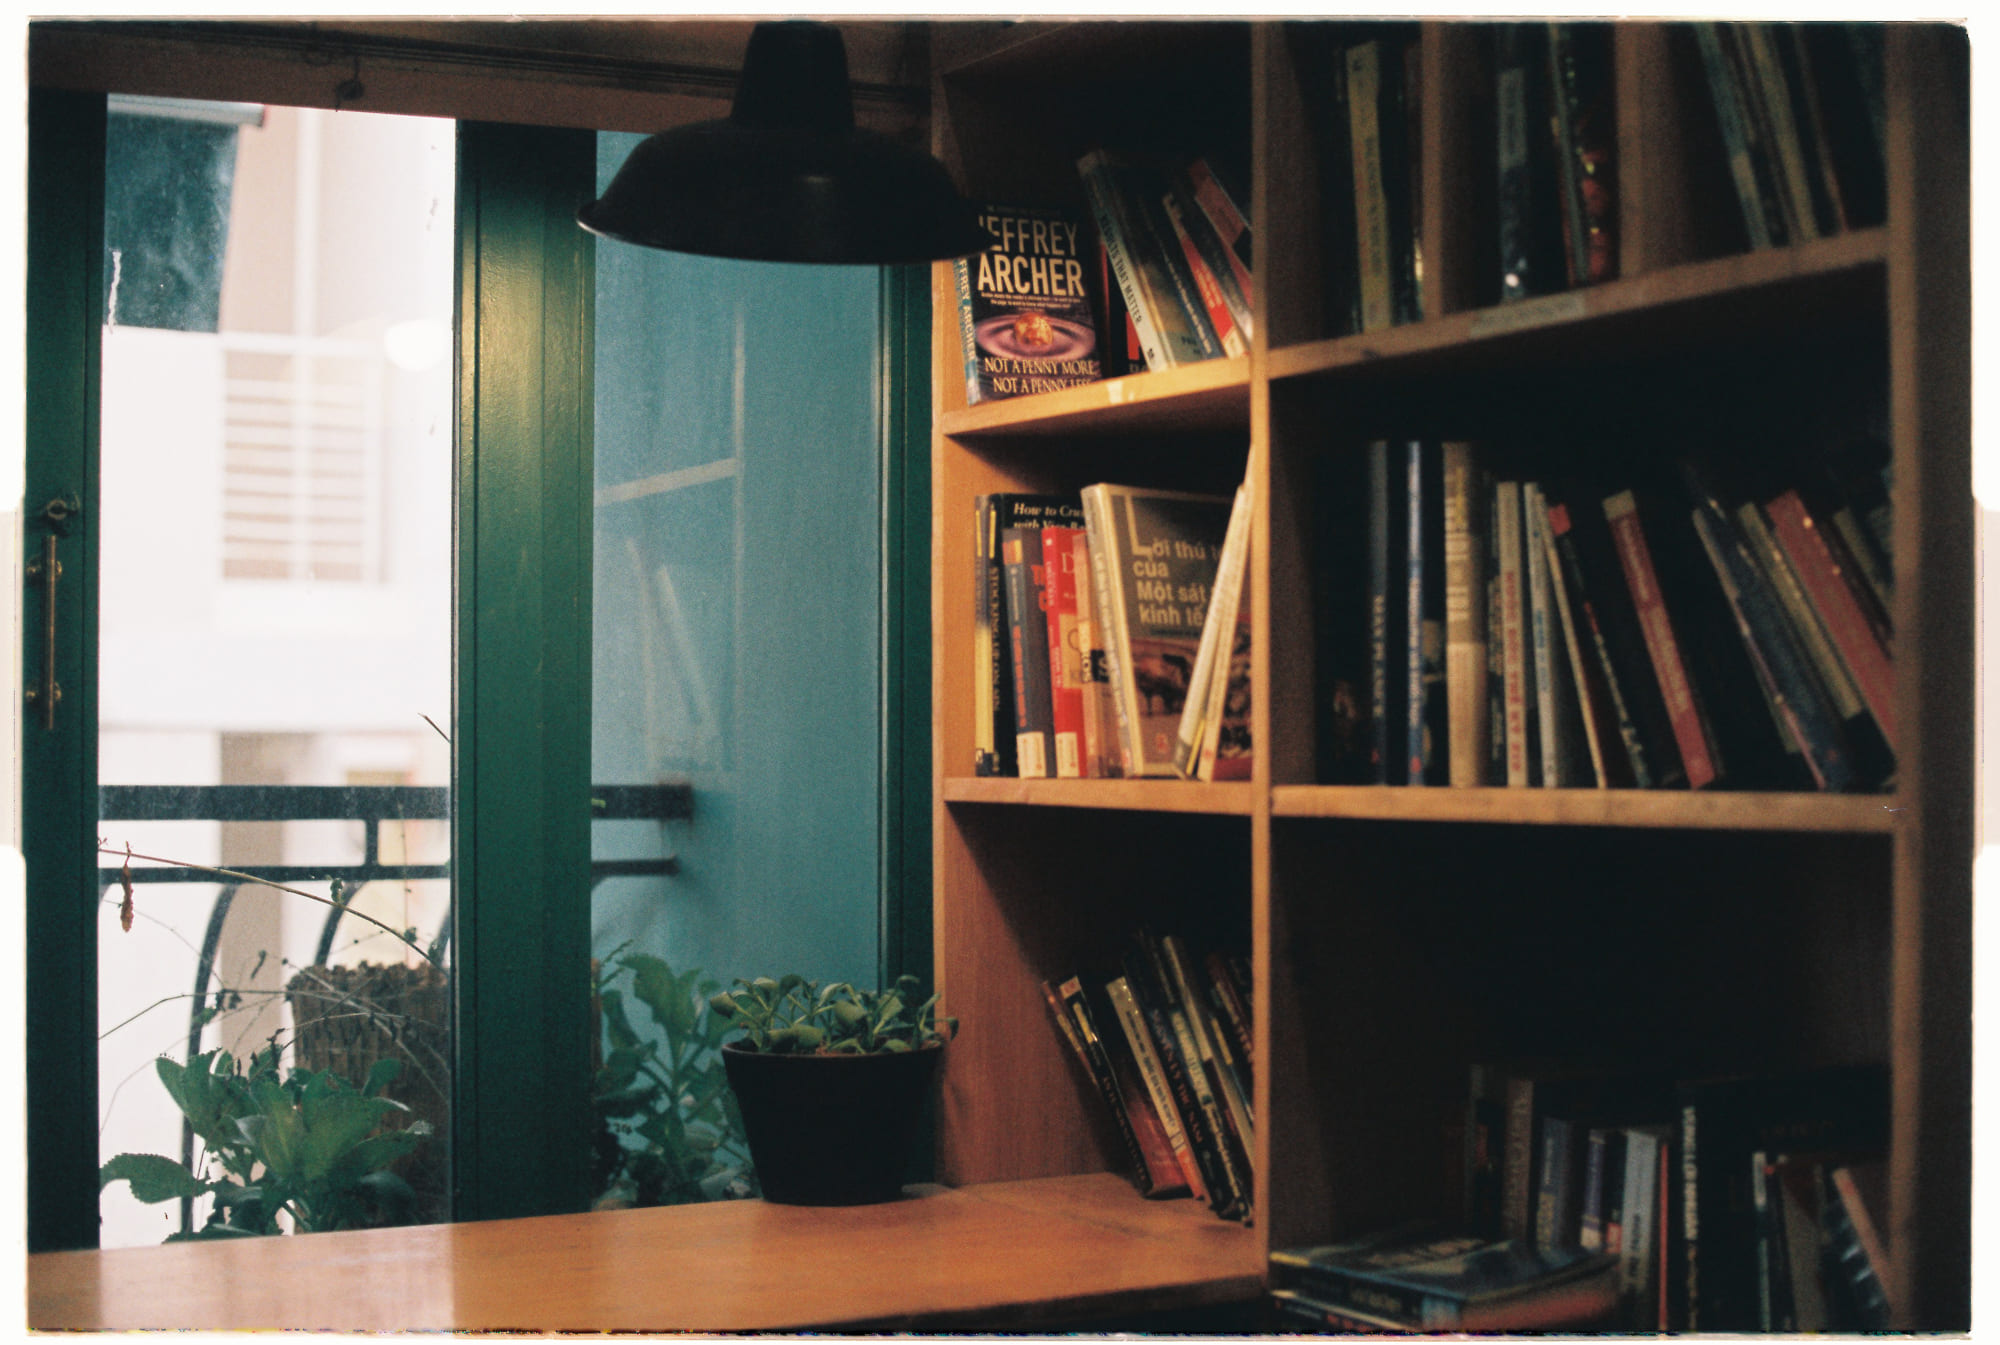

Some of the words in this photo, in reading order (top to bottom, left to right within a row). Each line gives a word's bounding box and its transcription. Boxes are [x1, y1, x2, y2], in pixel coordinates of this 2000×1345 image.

[979, 215, 1077, 256] EFFREY
[959, 258, 971, 300] FFREY
[978, 252, 1084, 296] ARCHER
[1114, 254, 1129, 284] THAT
[1124, 284, 1143, 325] MATTER
[962, 305, 976, 361] ARCHER
[985, 357, 1008, 373] NOT
[1012, 360, 1020, 374] A
[1022, 359, 1058, 375] PENNY
[993, 378, 1017, 394] NOT
[1020, 379, 1030, 393] A
[1031, 377, 1066, 393] PENNY
[1014, 502, 1041, 516] How
[1045, 506, 1056, 516] to
[1060, 505, 1085, 518] Cru
[1136, 580, 1173, 605] Một
[1178, 583, 1207, 604] sát
[1139, 602, 1181, 625] kinh
